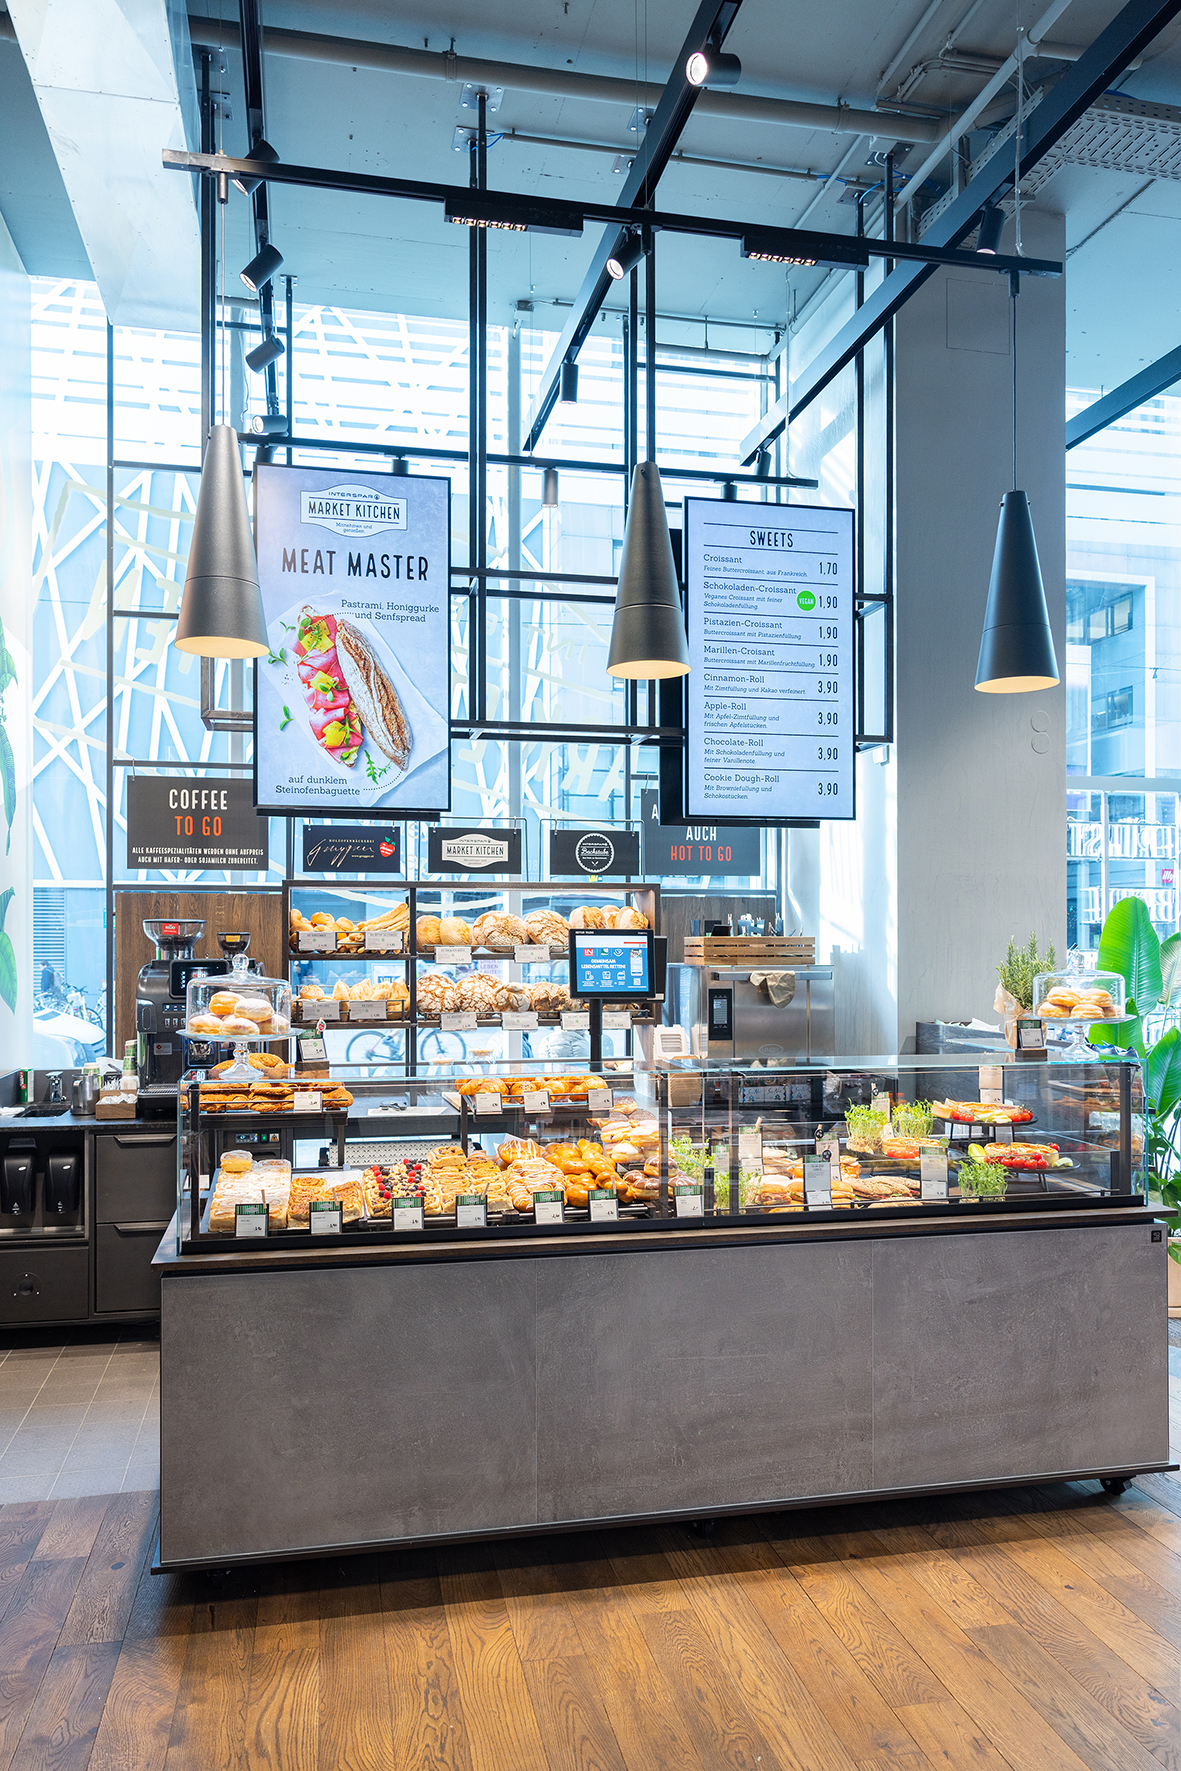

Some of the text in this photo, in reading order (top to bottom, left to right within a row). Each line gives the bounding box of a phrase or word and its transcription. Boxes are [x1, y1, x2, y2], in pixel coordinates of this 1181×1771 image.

[308, 501, 400, 520] MARKET KITCHEN
[750, 530, 794, 548] SWEETS
[282, 548, 428, 580] MEAT MASTER
[704, 554, 742, 564] Croissant
[819, 562, 838, 576] 1,70
[704, 582, 796, 594] Schokoladen-Croissant
[728, 594, 754, 602] Croissant
[818, 596, 838, 609] 1,90
[386, 602, 440, 614] Honiggurke
[374, 612, 426, 623] Senfspread
[704, 618, 782, 629] Pistazien-Croissant
[818, 626, 838, 640] 1,90
[704, 645, 774, 656] Marillen-Croisant
[818, 654, 838, 666] 1,90
[704, 674, 764, 683] Cinnamon-Roll
[818, 680, 838, 694] 3,90
[704, 702, 747, 711] Apple-Roll
[818, 712, 838, 726] 3,90
[704, 738, 764, 747] Chocolate-Roll
[818, 747, 838, 760] 3,90
[288, 775, 348, 785] auf dunklem
[704, 774, 780, 784] Cookie Dough-Roll
[275, 785, 360, 796] Steinofenbaguette
[818, 782, 838, 796] 3,90
[168, 788, 228, 810] COFFEE
[174, 816, 222, 836] TO GO
[686, 826, 717, 841] AUCH
[132, 846, 144, 854] ALLE
[146, 846, 202, 854] KAFFEESPEZIALITÄTEN
[225, 848, 238, 856] OHNE
[240, 848, 264, 856] AUFPREIS
[446, 846, 504, 856] MARKET KITCHEN
[670, 845, 732, 862] HOT TO GO
